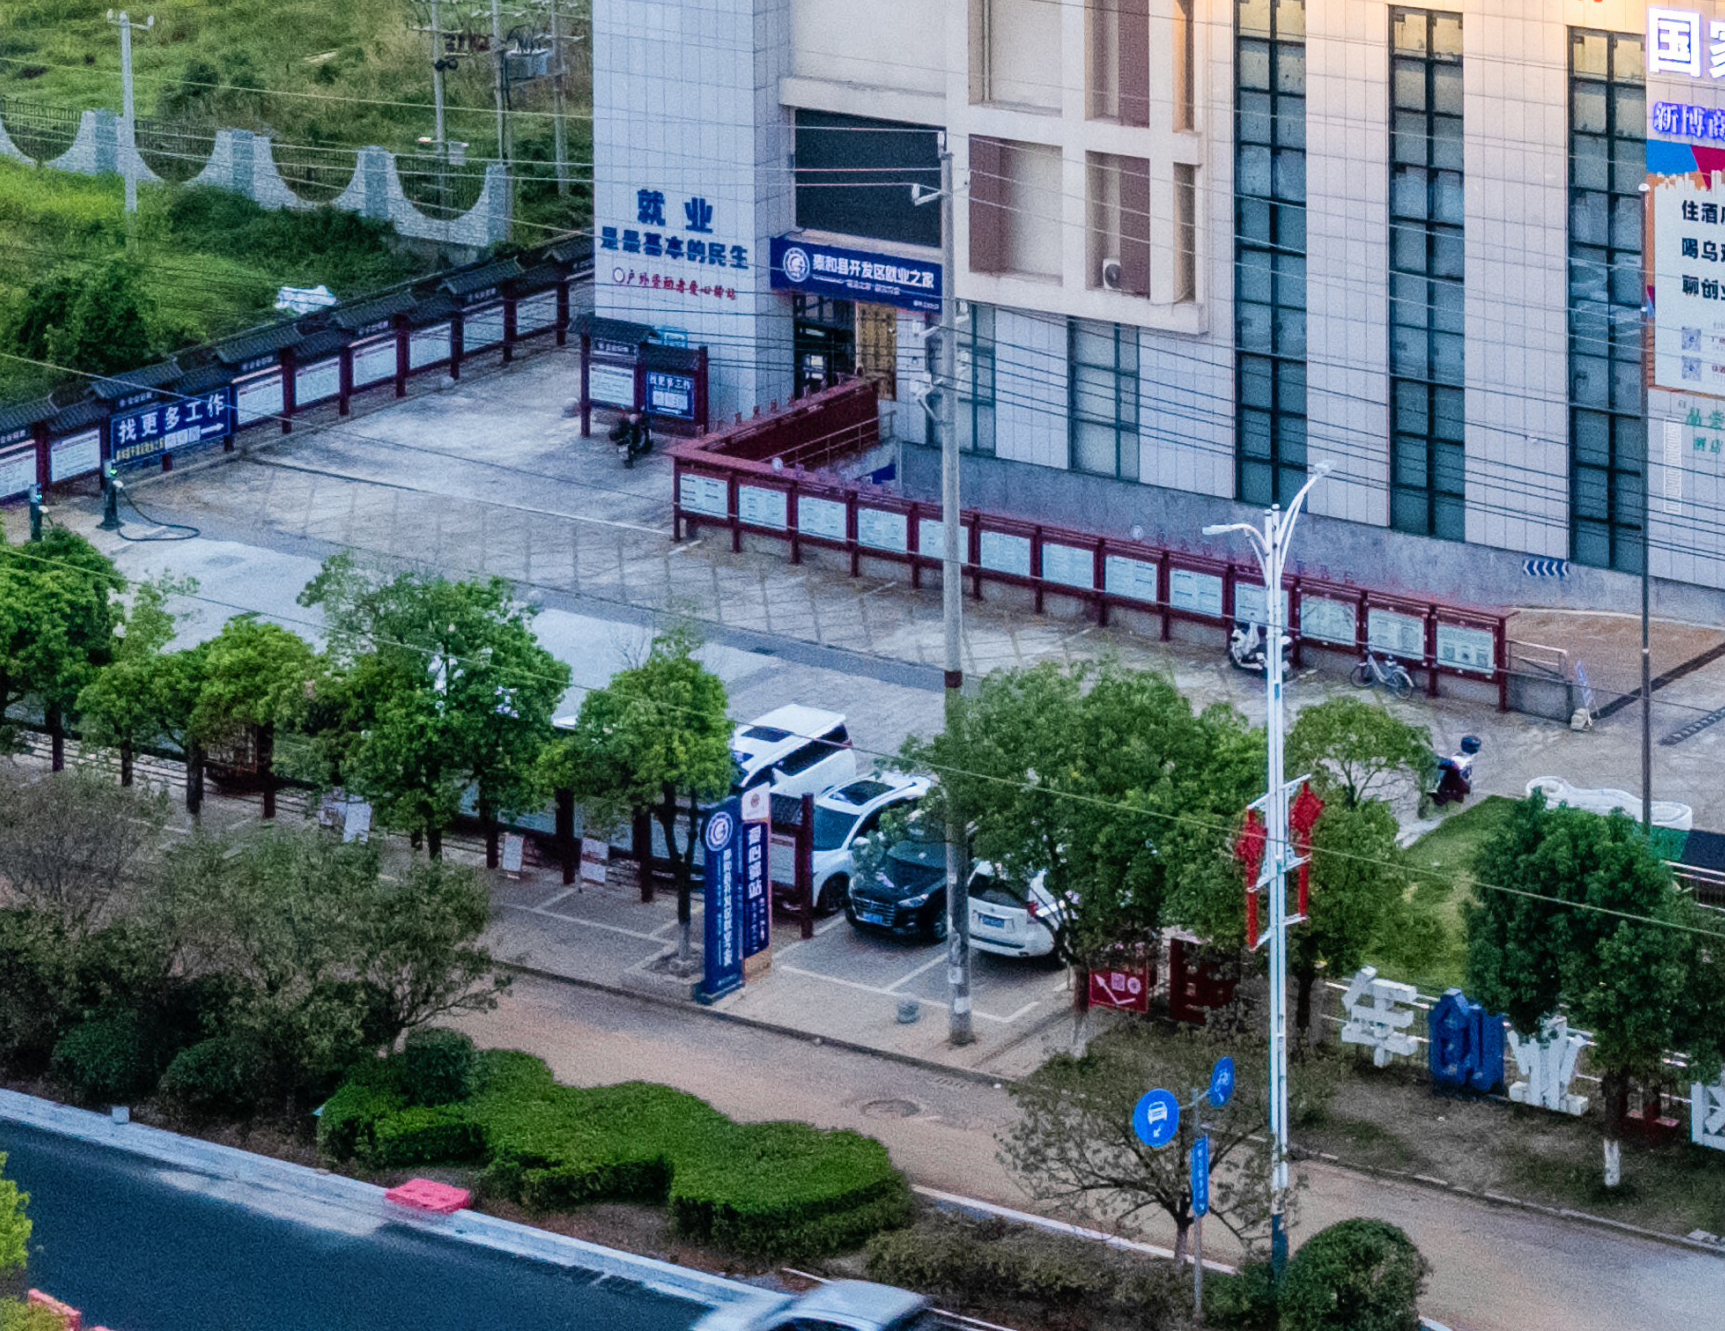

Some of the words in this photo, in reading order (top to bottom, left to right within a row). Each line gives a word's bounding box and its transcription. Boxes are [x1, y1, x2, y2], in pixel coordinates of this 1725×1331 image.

[637, 189, 713, 234] 就业
[600, 226, 749, 270] 是最基本的民生
[118, 393, 225, 444] 找更多工作
